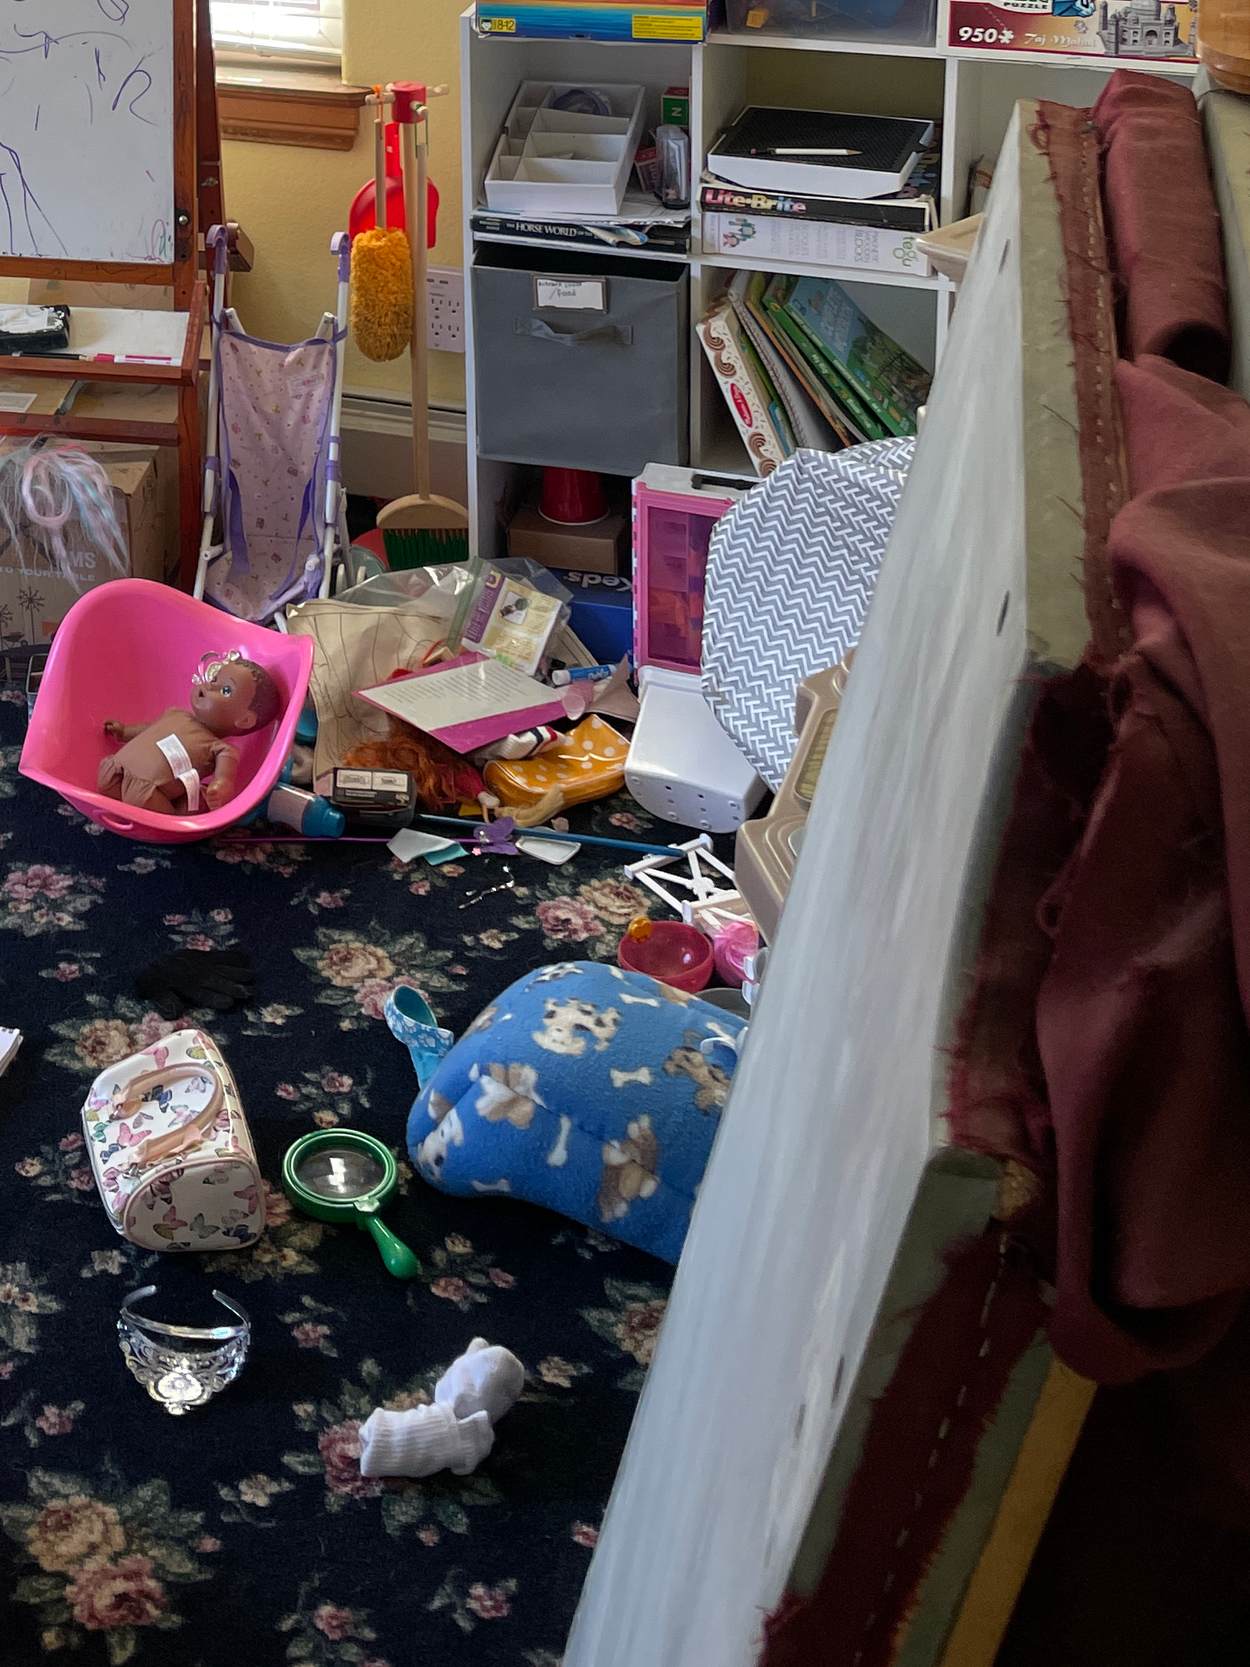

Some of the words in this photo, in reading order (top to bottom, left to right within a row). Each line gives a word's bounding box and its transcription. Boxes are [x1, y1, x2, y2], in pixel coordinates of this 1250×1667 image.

[959, 27, 999, 43] 950
[516, 222, 542, 233] HORSE
[544, 225, 577, 237] WORLD
[893, 236, 917, 268] tegu
